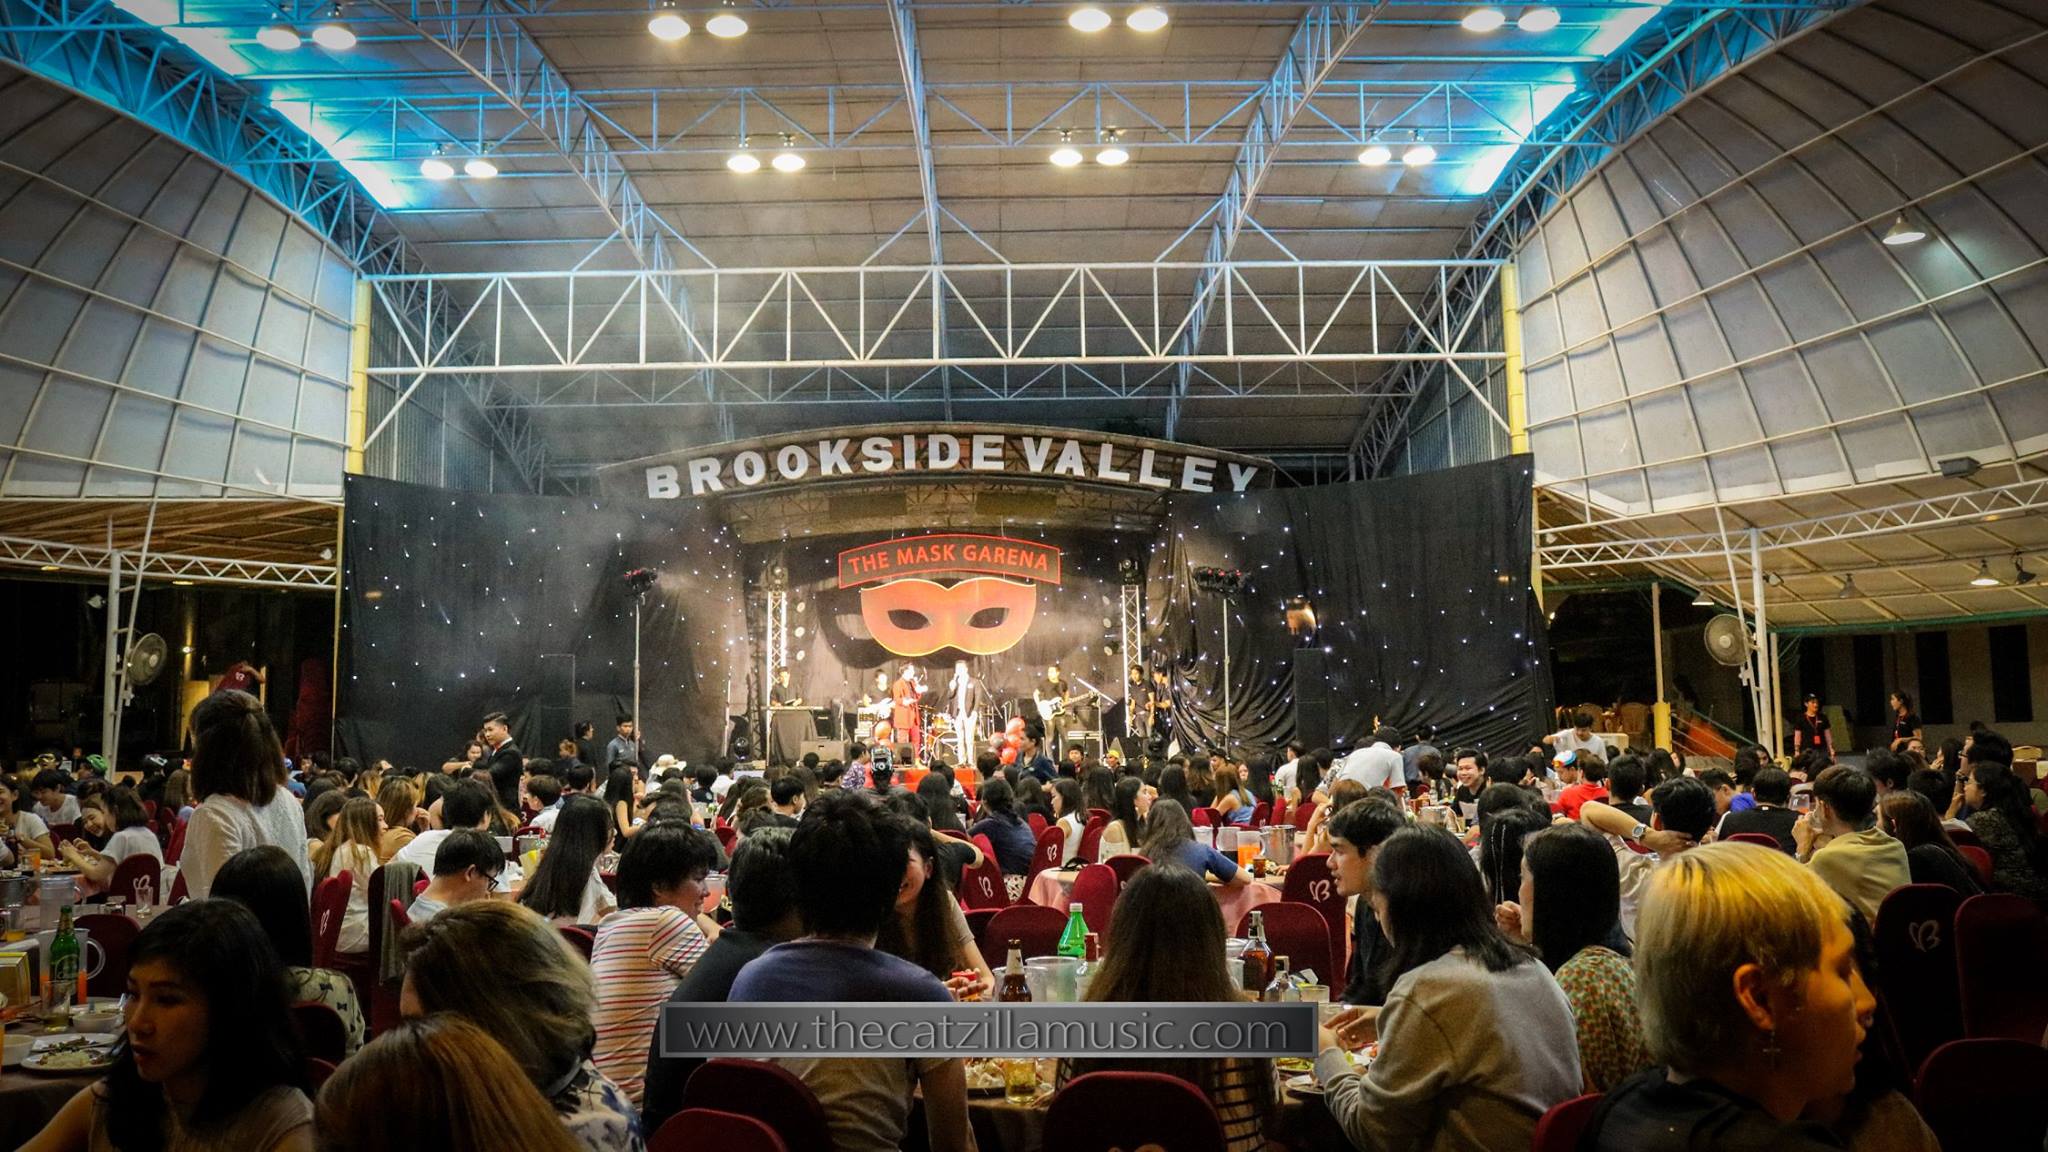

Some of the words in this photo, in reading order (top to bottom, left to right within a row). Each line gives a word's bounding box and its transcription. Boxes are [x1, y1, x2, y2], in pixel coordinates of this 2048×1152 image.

[646, 434, 1004, 499] BROOKSIDE
[1022, 436, 1258, 493] VALLEY
[848, 551, 890, 575] THE
[896, 544, 956, 564] MASK
[963, 545, 1048, 571] GARENA
